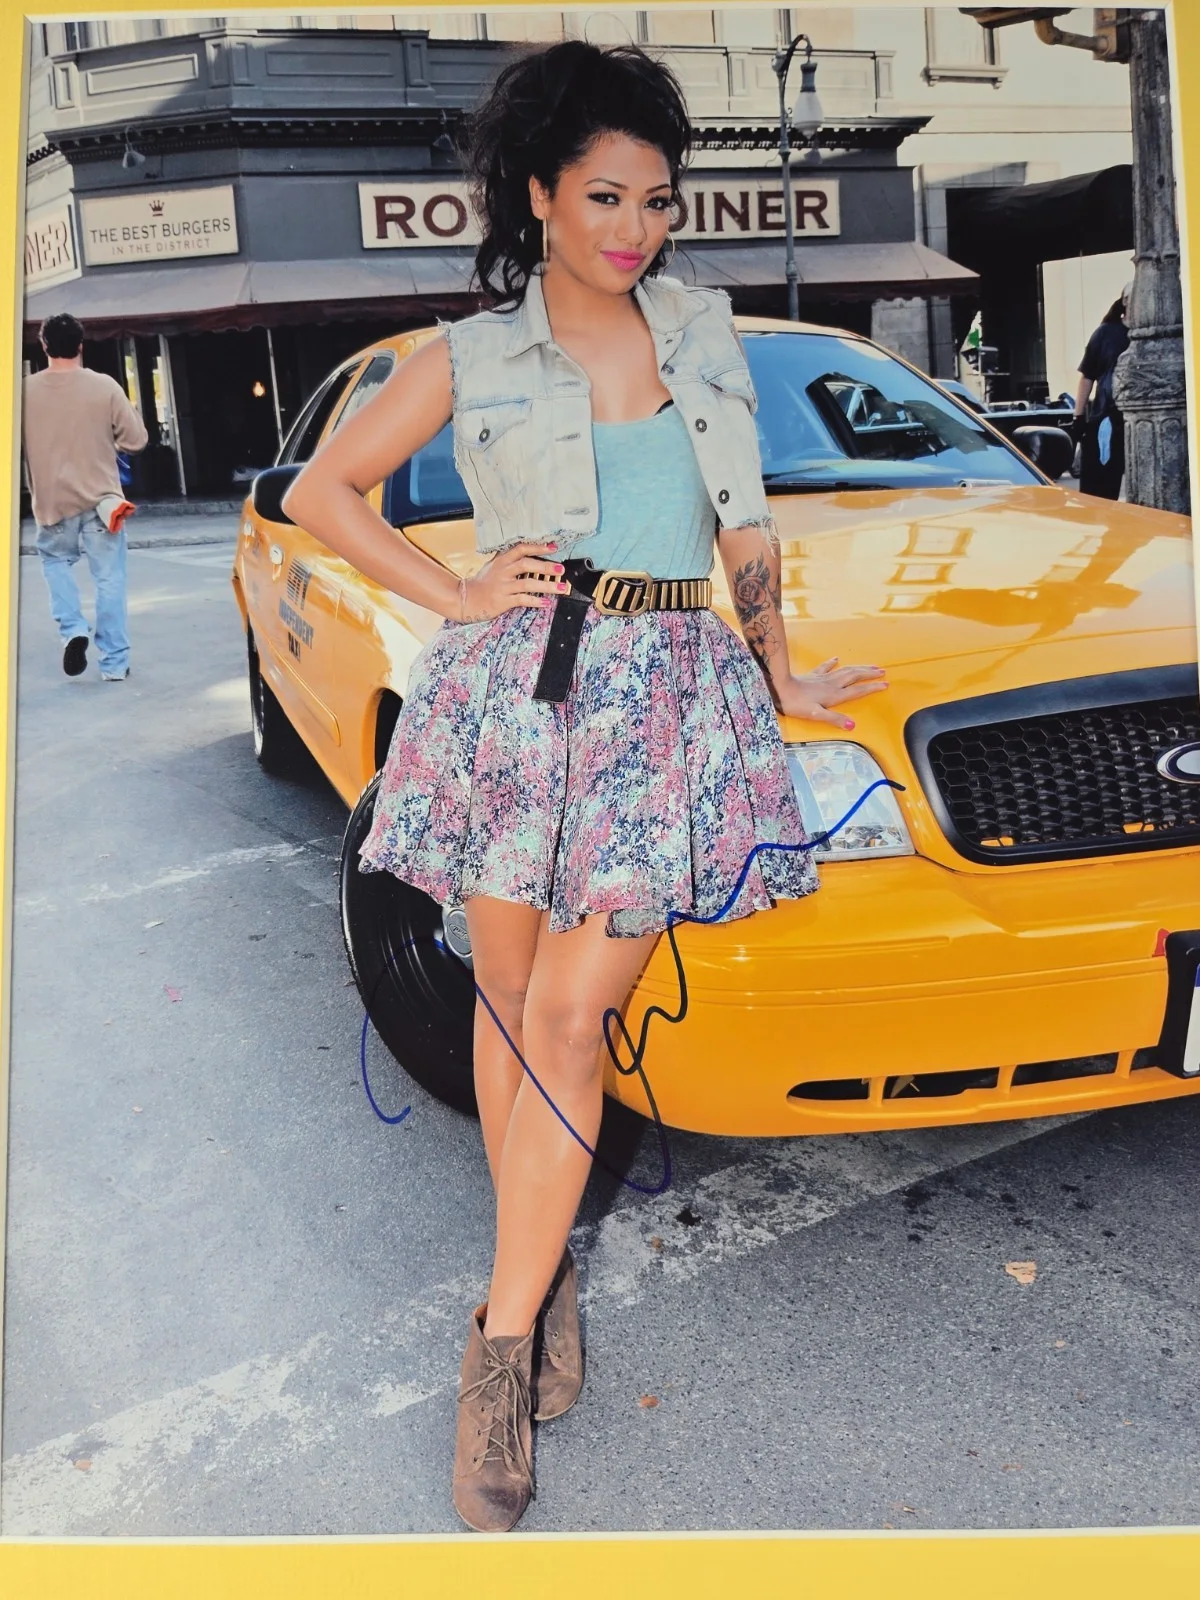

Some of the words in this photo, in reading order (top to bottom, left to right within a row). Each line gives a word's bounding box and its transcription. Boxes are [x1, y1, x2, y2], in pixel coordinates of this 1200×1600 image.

[90, 228, 118, 244] THE
[122, 224, 157, 241] BEST
[161, 217, 231, 238] BURGERS
[25, 220, 71, 276] NER
[111, 246, 124, 256] IN
[129, 243, 151, 254] THE
[156, 238, 211, 252] DISTRICT
[287, 631, 301, 663] TAXI
